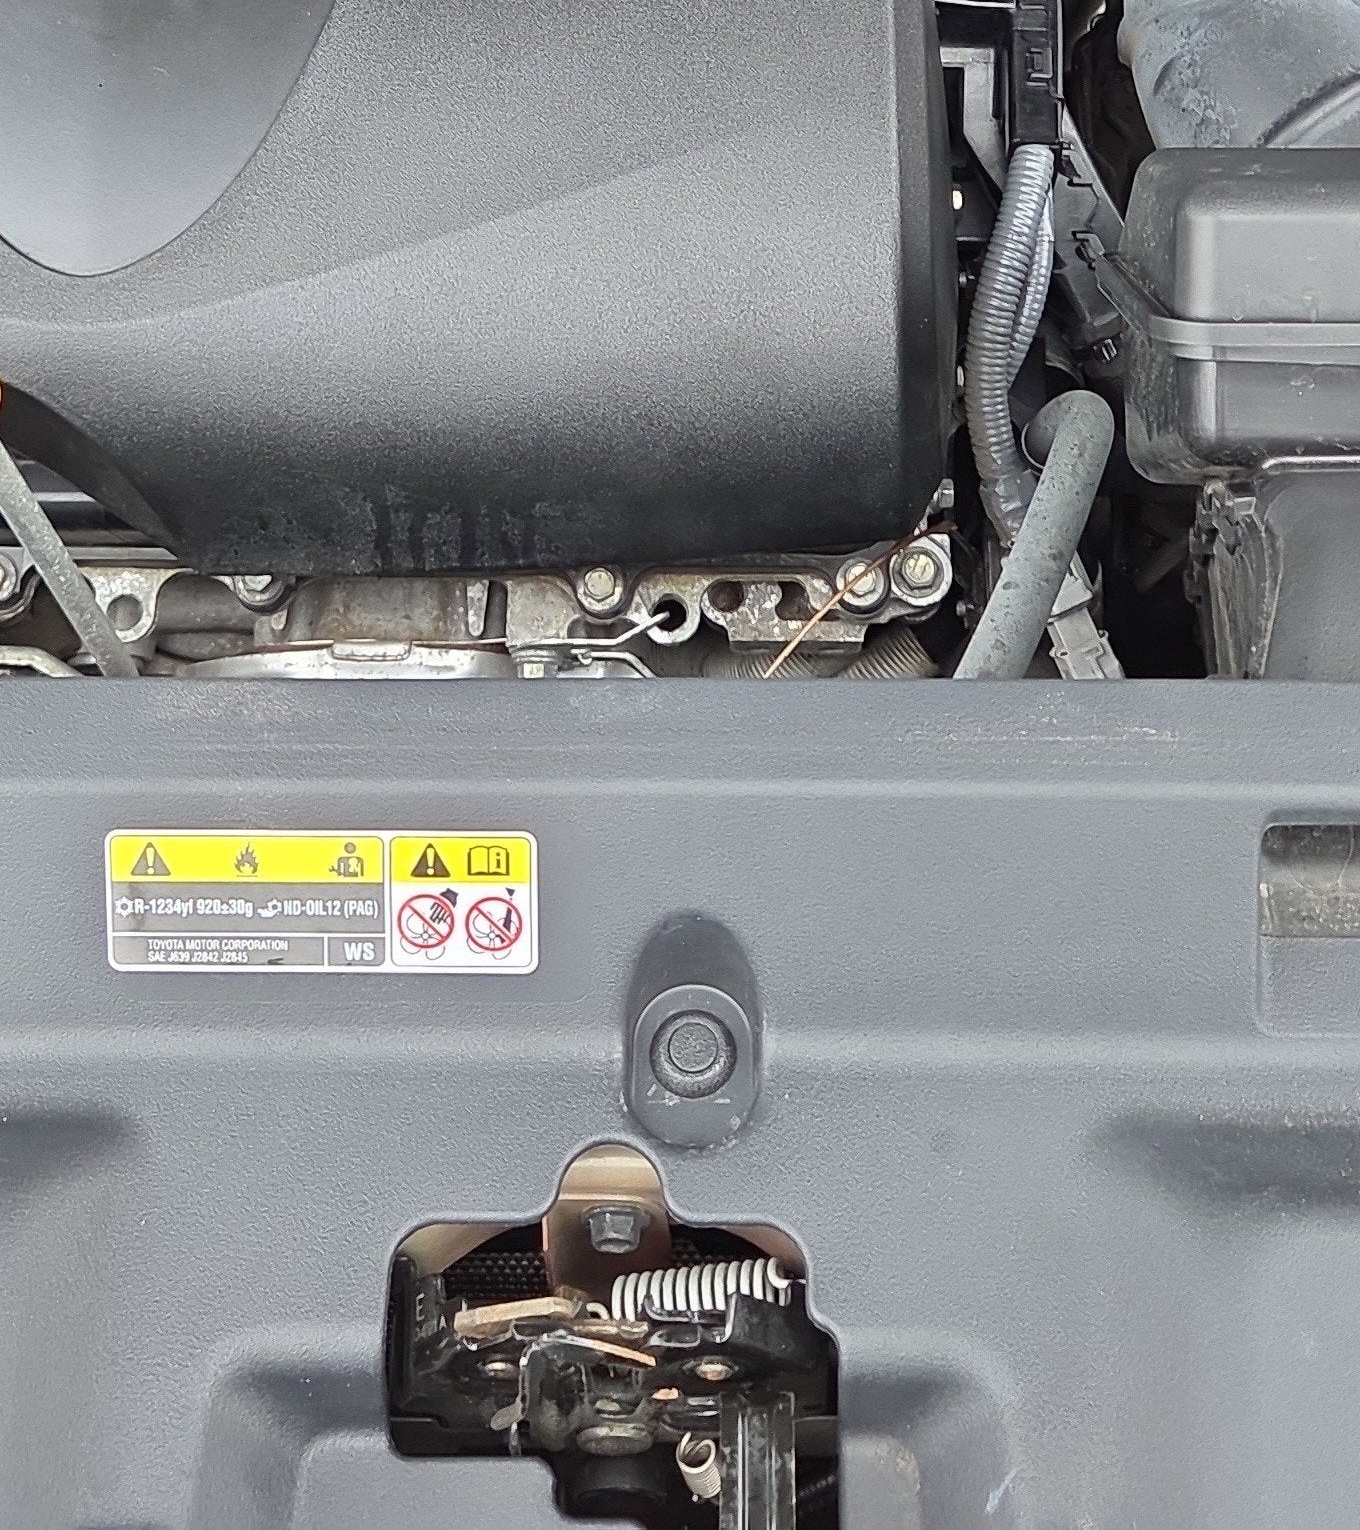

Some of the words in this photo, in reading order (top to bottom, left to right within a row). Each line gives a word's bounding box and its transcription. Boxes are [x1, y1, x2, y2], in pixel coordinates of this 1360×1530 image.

[136, 898, 194, 917] R-1234yf
[282, 898, 342, 917] ND-OIL12
[343, 899, 379, 919] (PAG)
[147, 938, 184, 951] TOYOTA
[185, 938, 220, 951] MOTOR
[221, 938, 289, 952] CORPORATION
[343, 942, 376, 962] WS
[147, 950, 166, 963] SAE
[167, 950, 190, 963] J639
